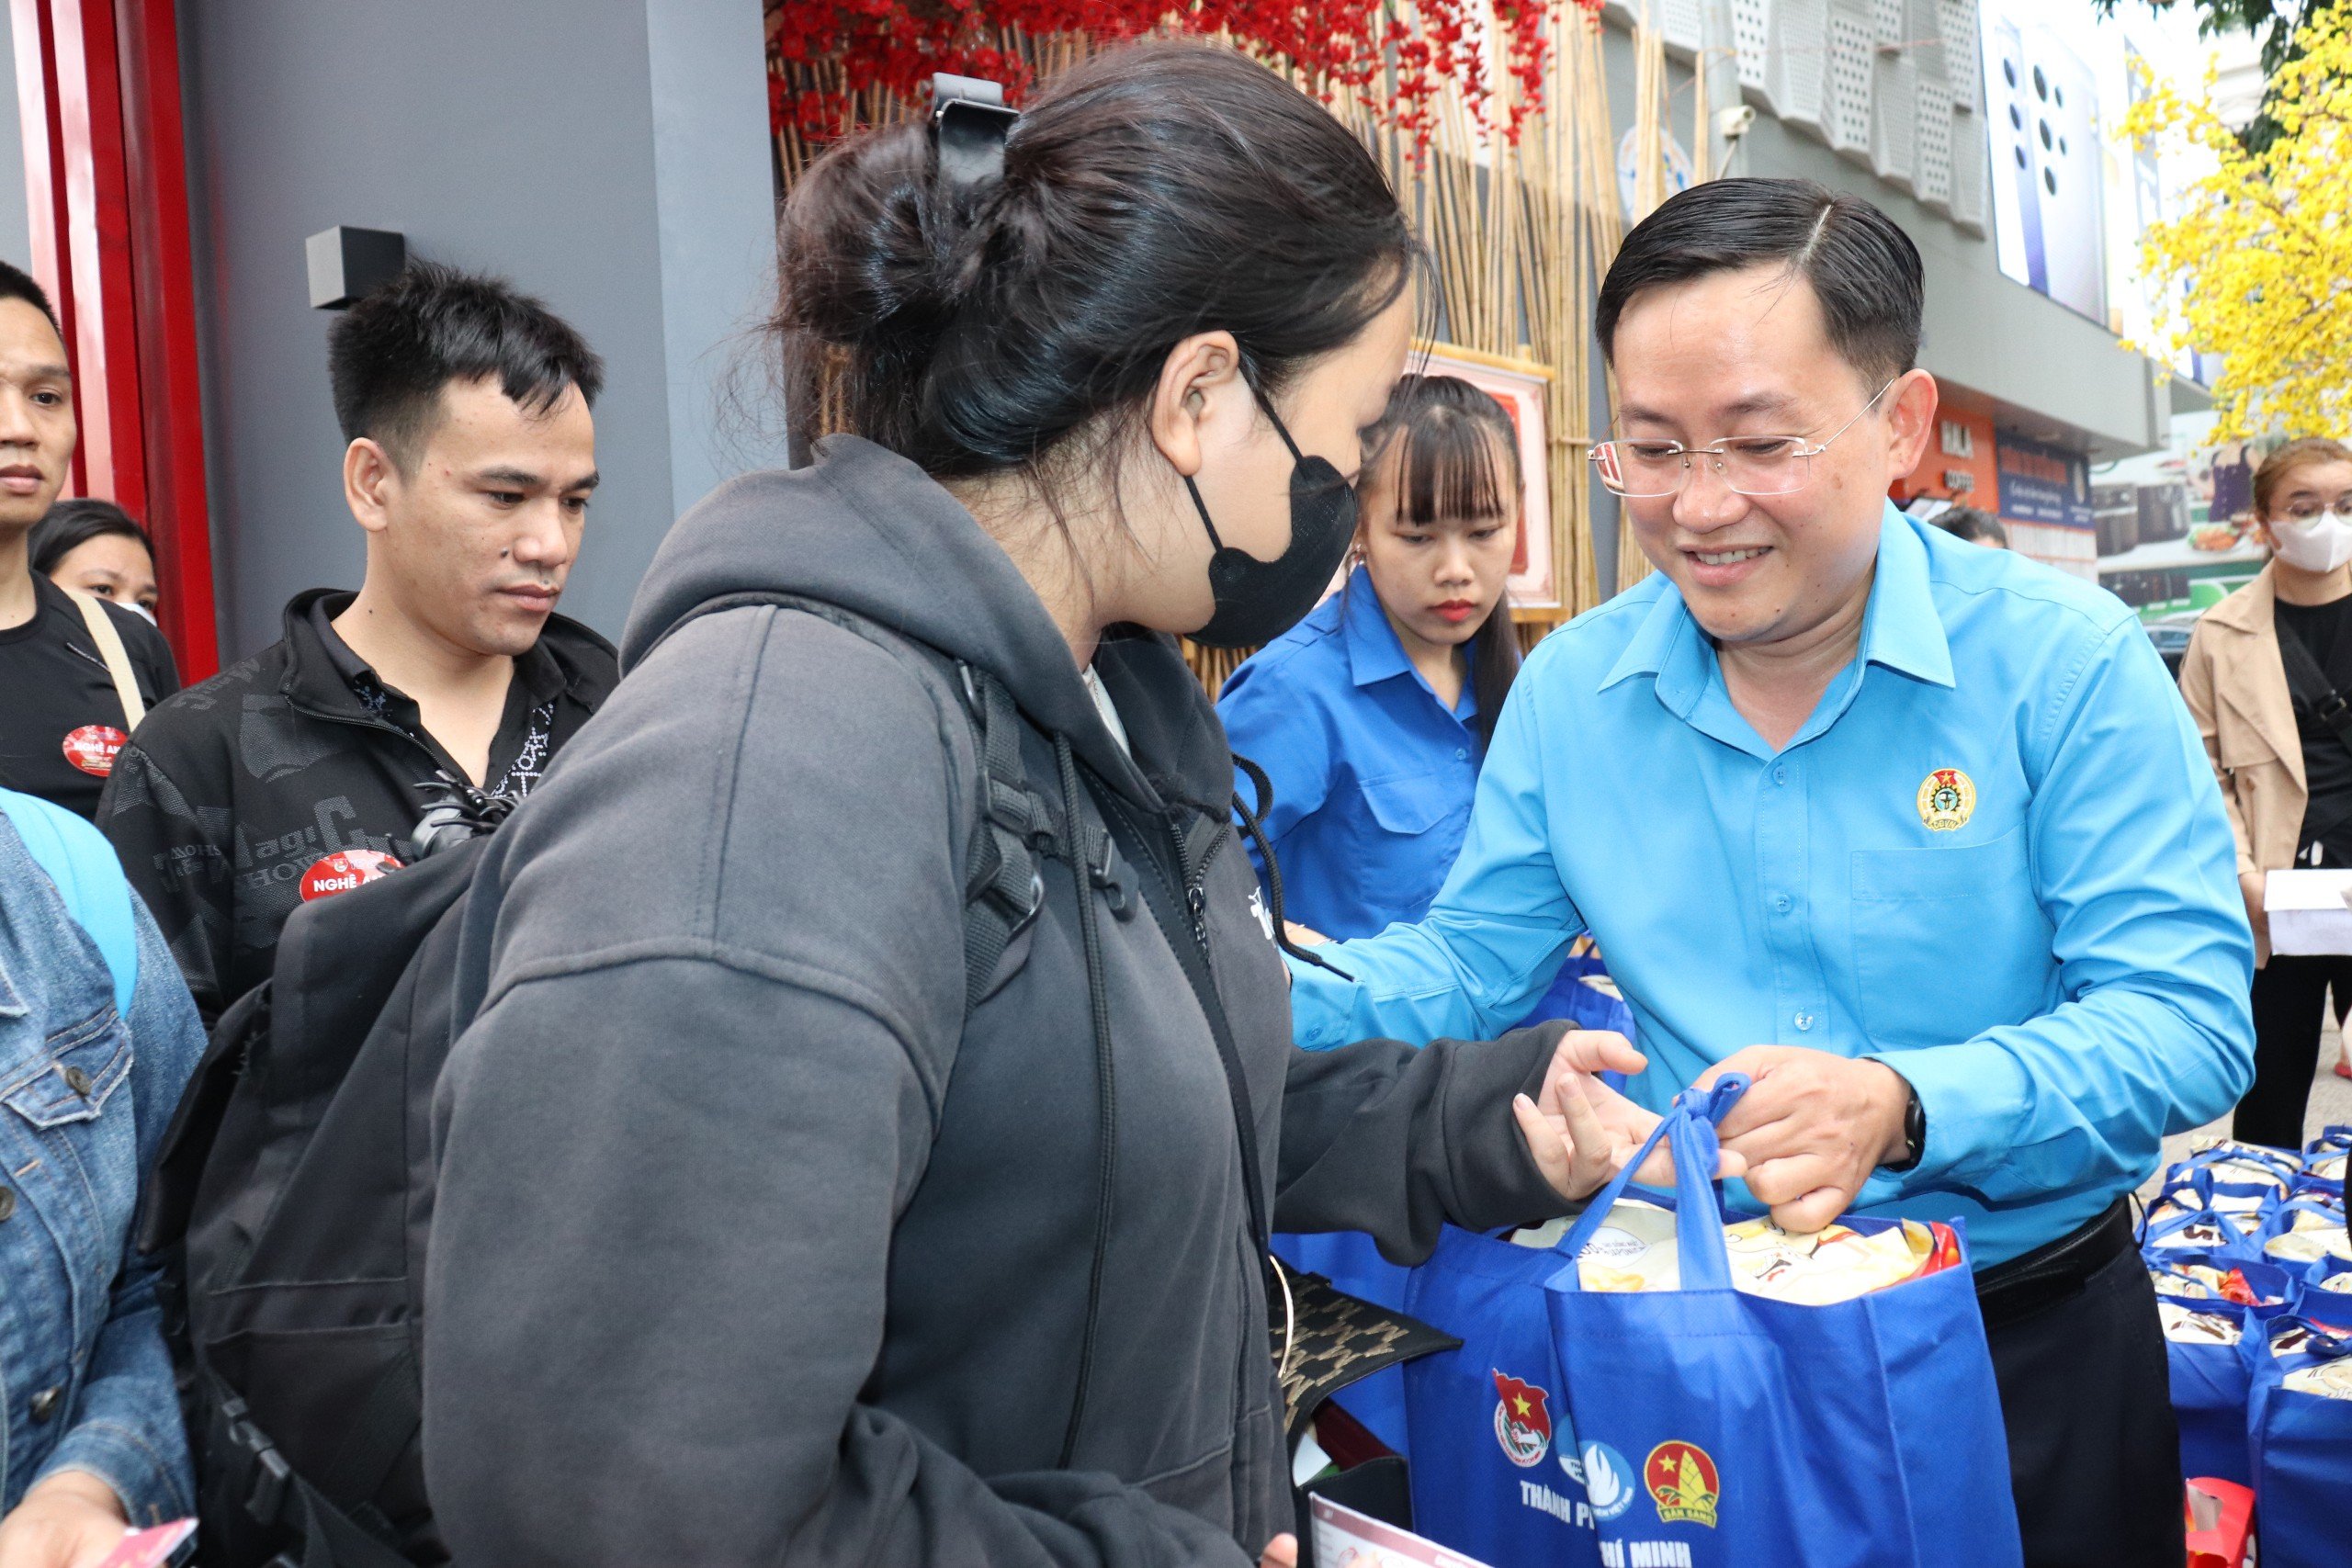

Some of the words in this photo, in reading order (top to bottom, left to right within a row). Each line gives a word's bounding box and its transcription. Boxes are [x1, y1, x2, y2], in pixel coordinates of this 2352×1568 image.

[1520, 1480, 1571, 1525] THÀNH
[1599, 1538, 1625, 1568] HÍ
[1629, 1540, 1692, 1568] MINH
